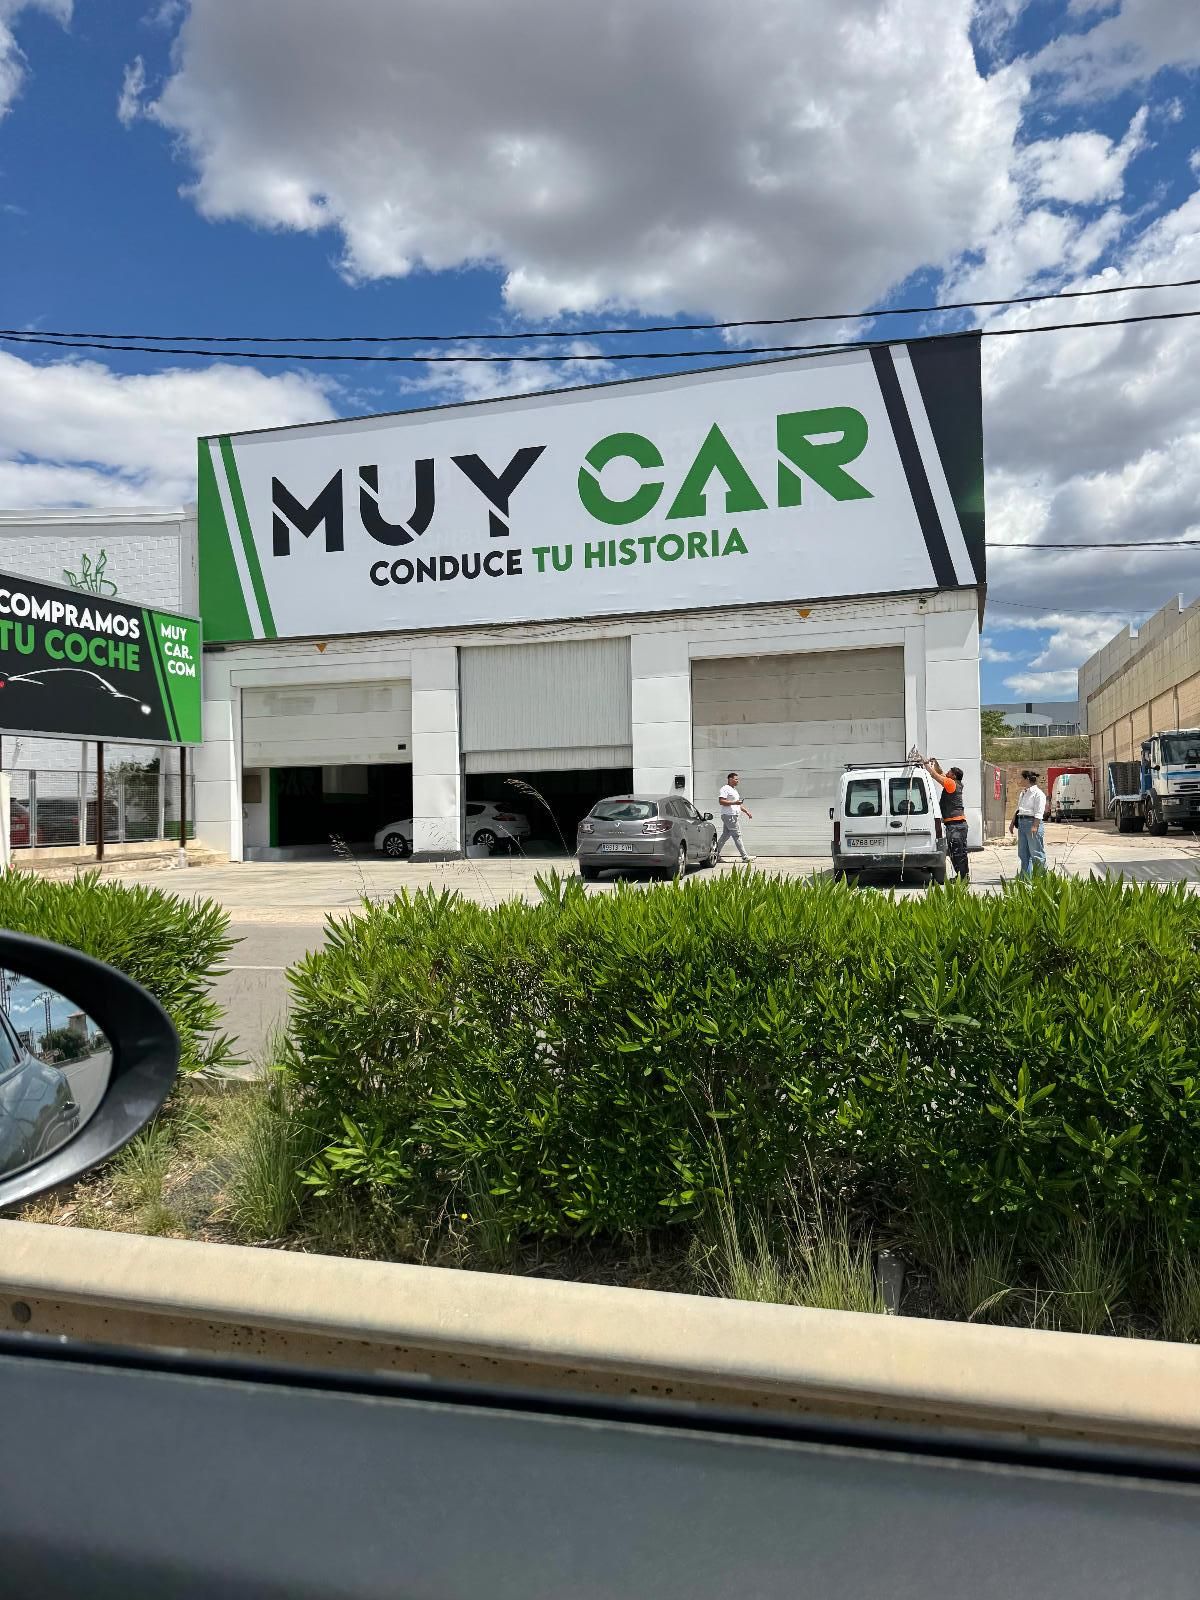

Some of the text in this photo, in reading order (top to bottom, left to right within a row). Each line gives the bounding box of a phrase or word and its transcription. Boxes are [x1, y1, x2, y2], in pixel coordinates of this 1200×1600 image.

[271, 406, 876, 557] MUY CAR
[369, 527, 749, 587] CONDUCE TU HISTORIA
[0, 588, 140, 639] COMPRAMOS
[160, 622, 188, 642] MUY
[0, 619, 141, 672] TU COCHE
[164, 641, 193, 660] CAR.
[167, 659, 196, 678] COM
